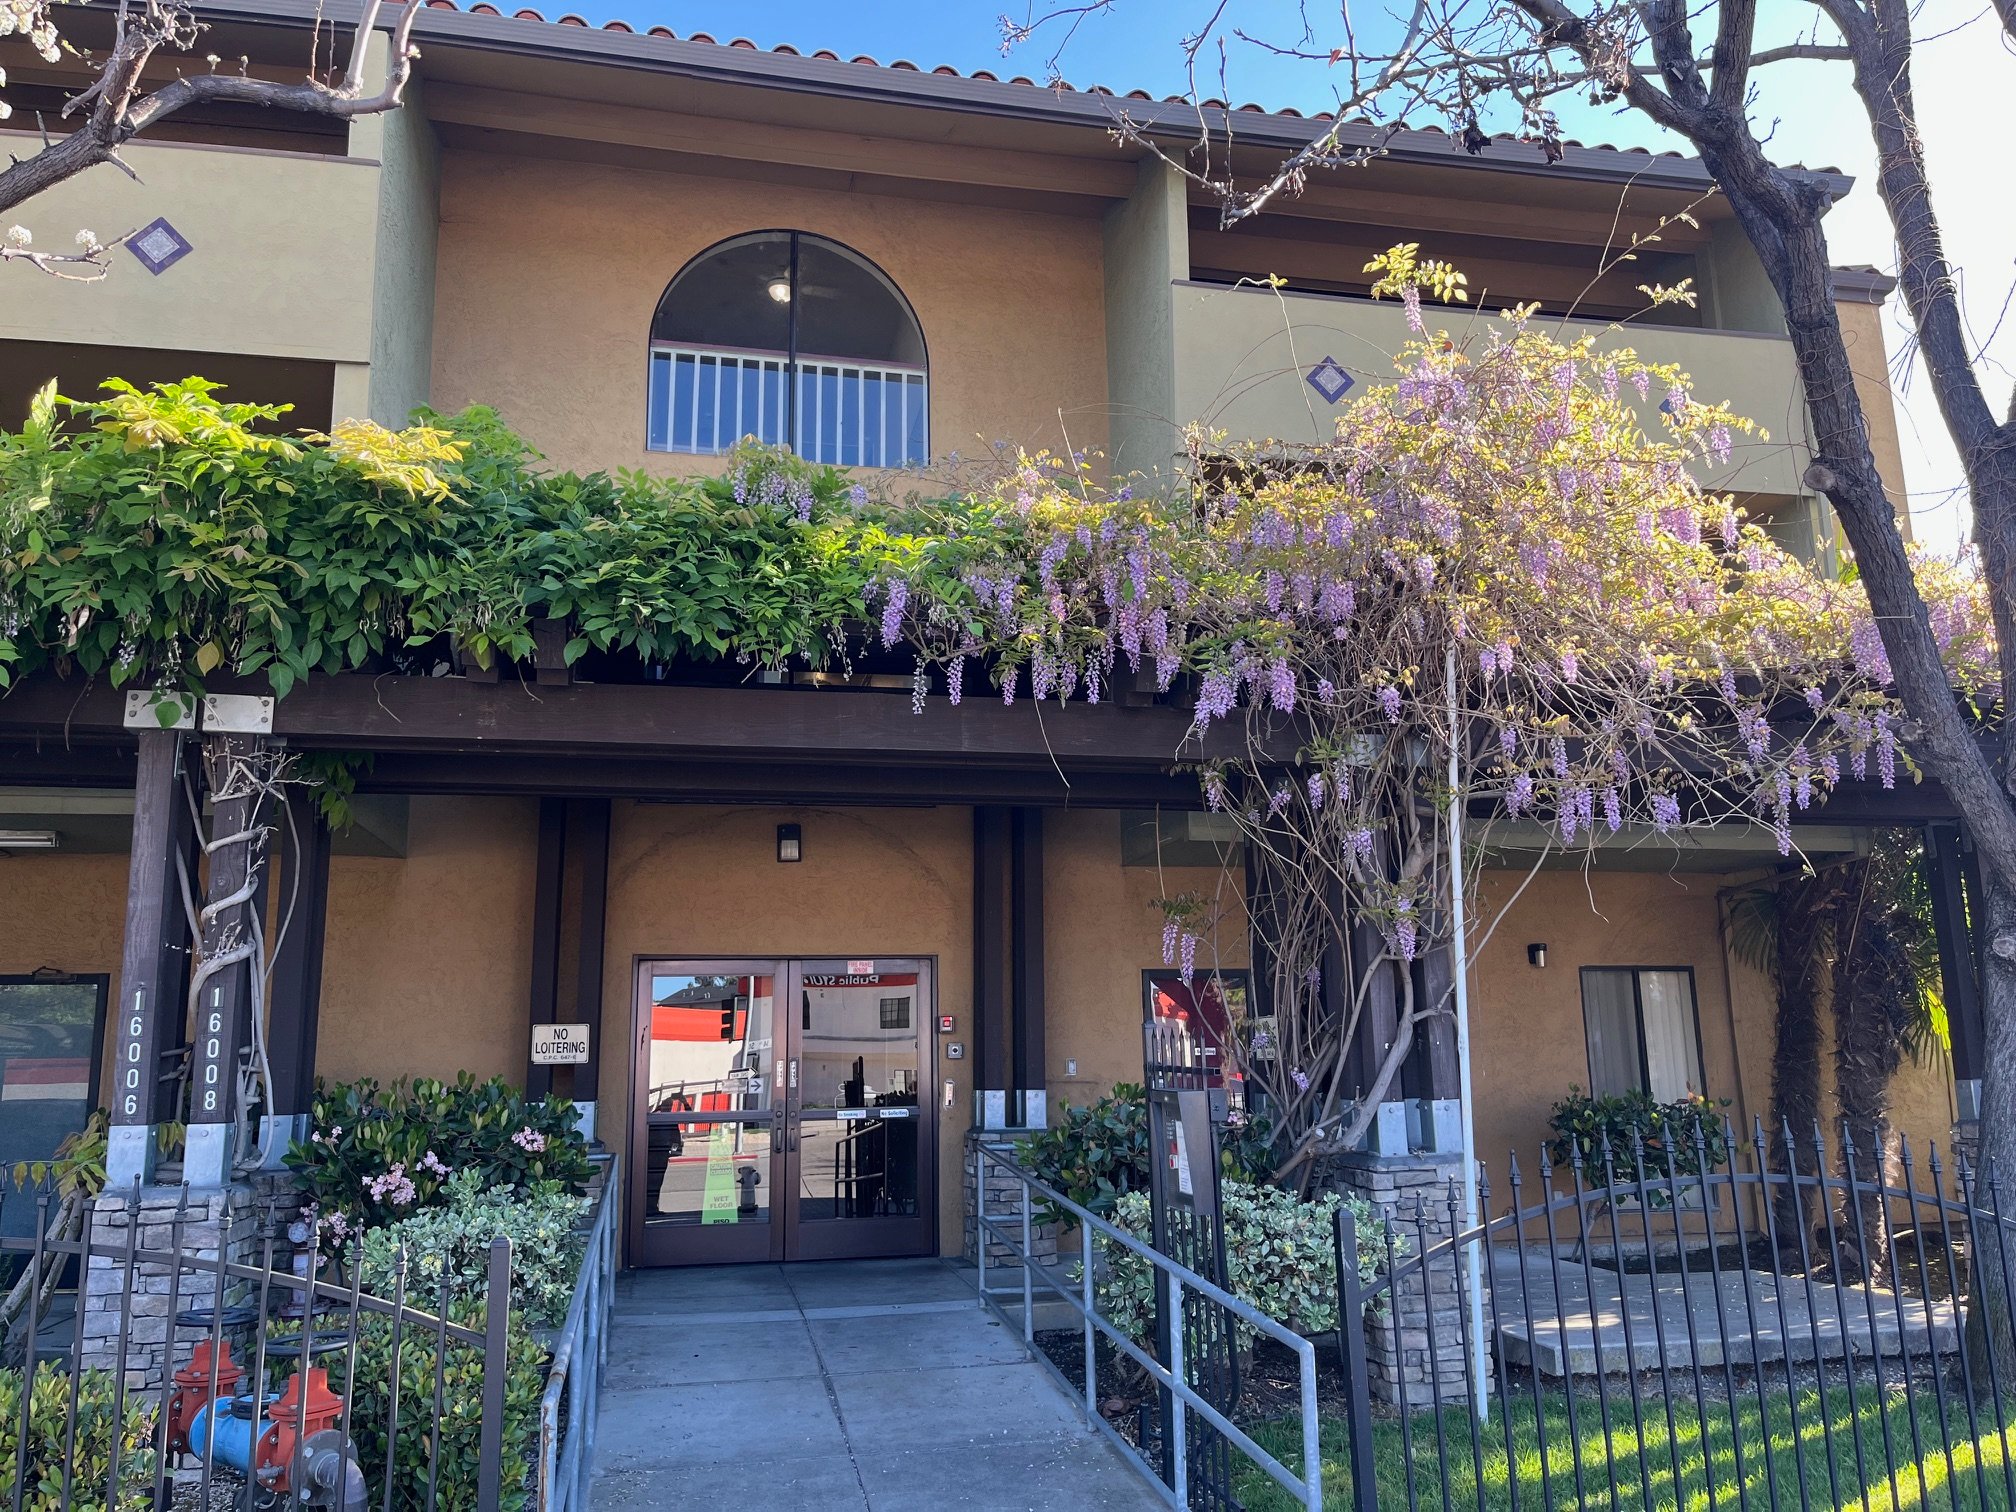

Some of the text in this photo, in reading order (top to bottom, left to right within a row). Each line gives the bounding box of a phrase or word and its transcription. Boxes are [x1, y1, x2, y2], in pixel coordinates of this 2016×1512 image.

[124, 990, 142, 1115] 16006
[204, 987, 221, 1110] 16008
[535, 1041, 586, 1054] LOITERING
[553, 1028, 568, 1040] NO
